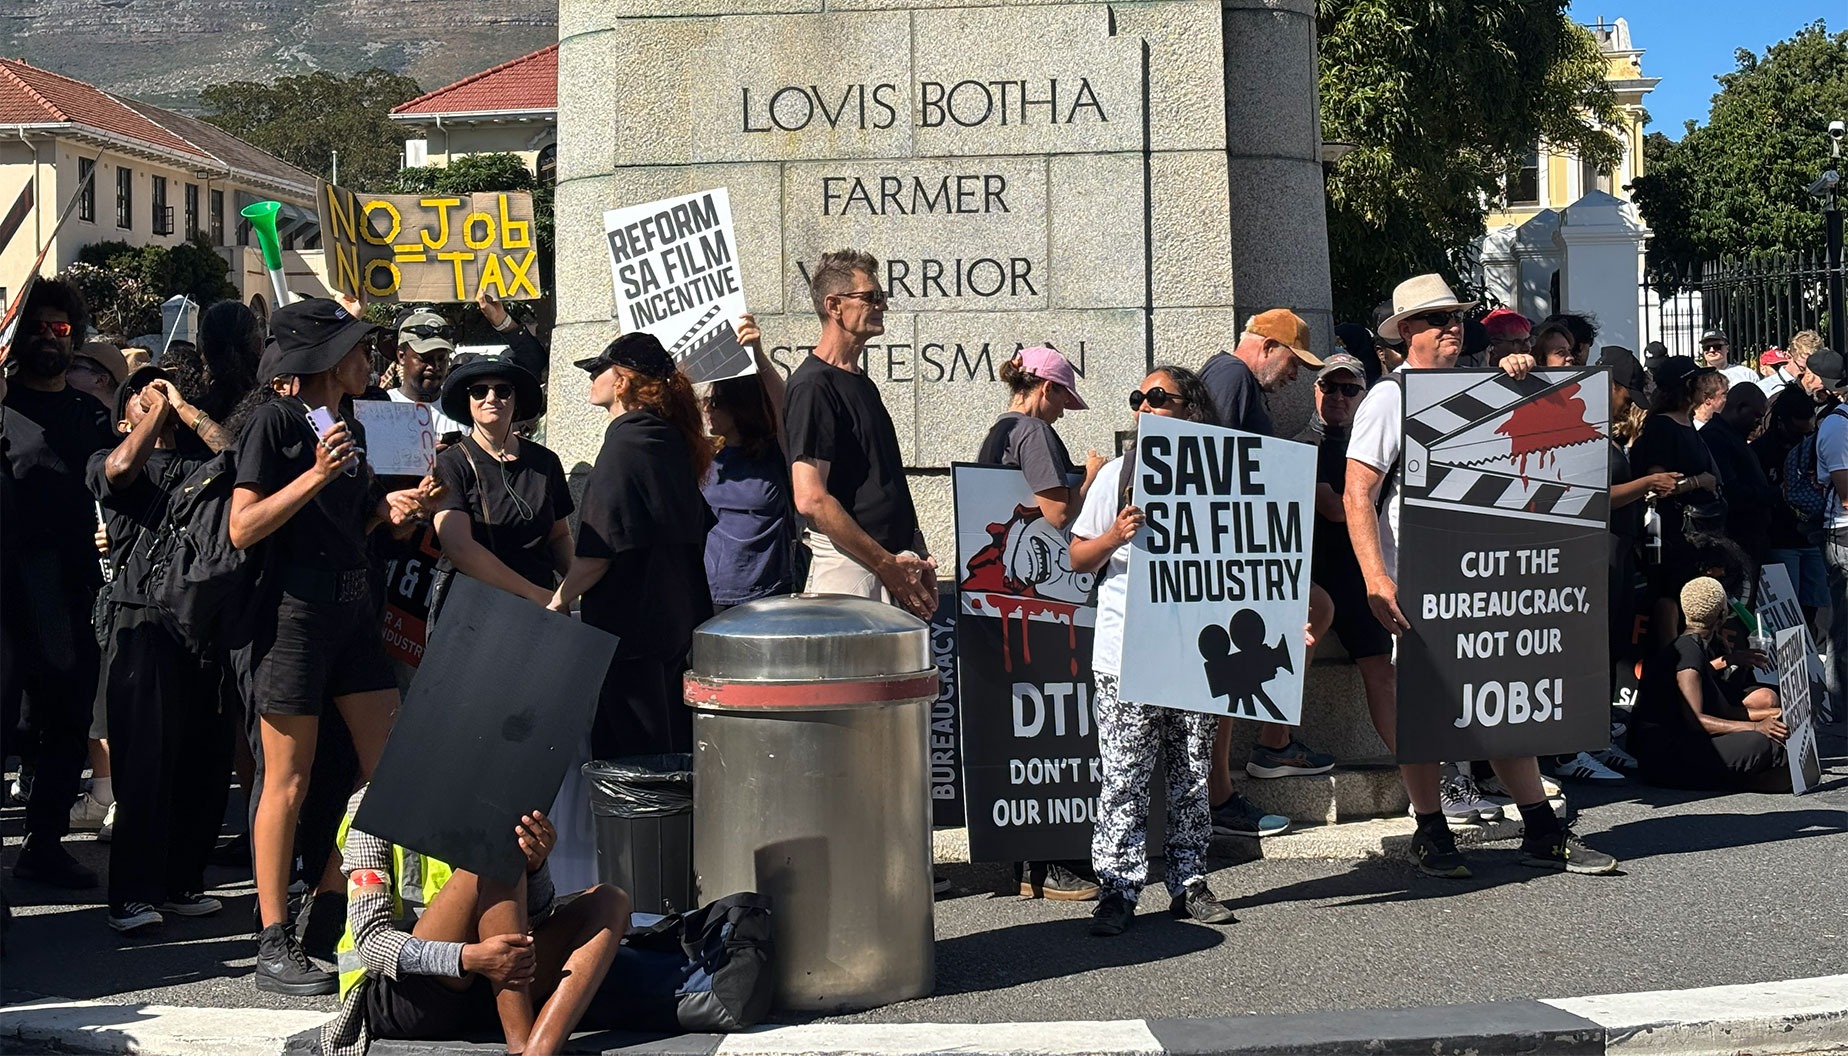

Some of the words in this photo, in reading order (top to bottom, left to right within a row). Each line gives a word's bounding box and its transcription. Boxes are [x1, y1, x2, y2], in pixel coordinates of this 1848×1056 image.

[915, 77, 1110, 128] BOTHA
[327, 184, 402, 246] NO
[822, 174, 1011, 216] FARMER
[607, 194, 720, 265] REFORM
[437, 249, 541, 301] TAX
[619, 258, 661, 300] SA
[660, 229, 731, 285] FILM
[629, 266, 740, 331] INCENTIVE
[1141, 435, 1266, 496] SAVE
[1145, 502, 1200, 555] SA
[1209, 501, 1303, 554] FILM
[1149, 559, 1303, 603] INDUSTRY
[1460, 550, 1510, 578] CUT
[1516, 548, 1560, 575] THE
[1422, 586, 1590, 620] BUREAUCRACY,
[1456, 631, 1509, 659] NOT
[1515, 628, 1563, 657] OUR
[1012, 682, 1101, 738] DTI
[1453, 678, 1563, 729] JOBS!
[1010, 757, 1082, 785] DON'T
[992, 799, 1041, 827] OUR
